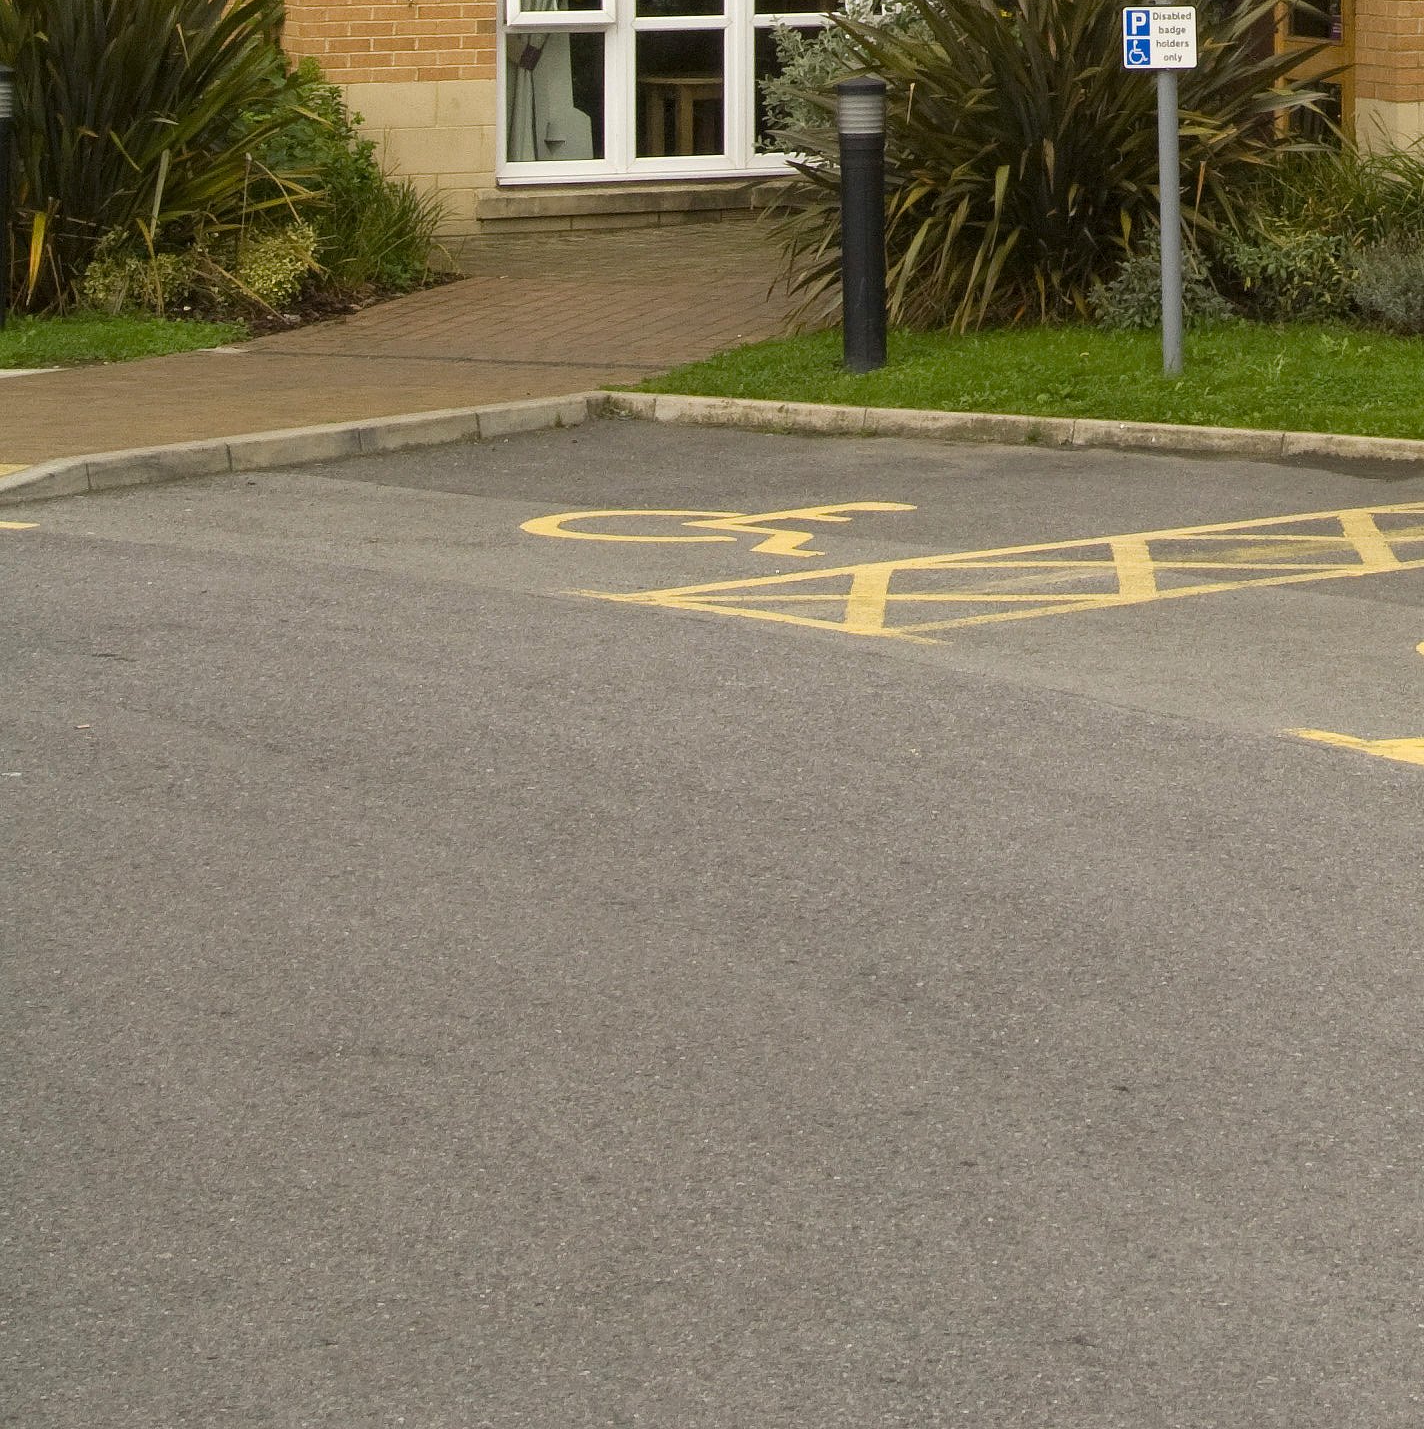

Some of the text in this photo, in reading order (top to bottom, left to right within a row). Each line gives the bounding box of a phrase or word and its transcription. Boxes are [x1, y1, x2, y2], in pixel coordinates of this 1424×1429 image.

[1152, 12, 1192, 21] Disabled
[1131, 12, 1147, 35] P
[1158, 26, 1186, 35] badge
[1156, 40, 1189, 48] holders
[1163, 53, 1182, 62] only
